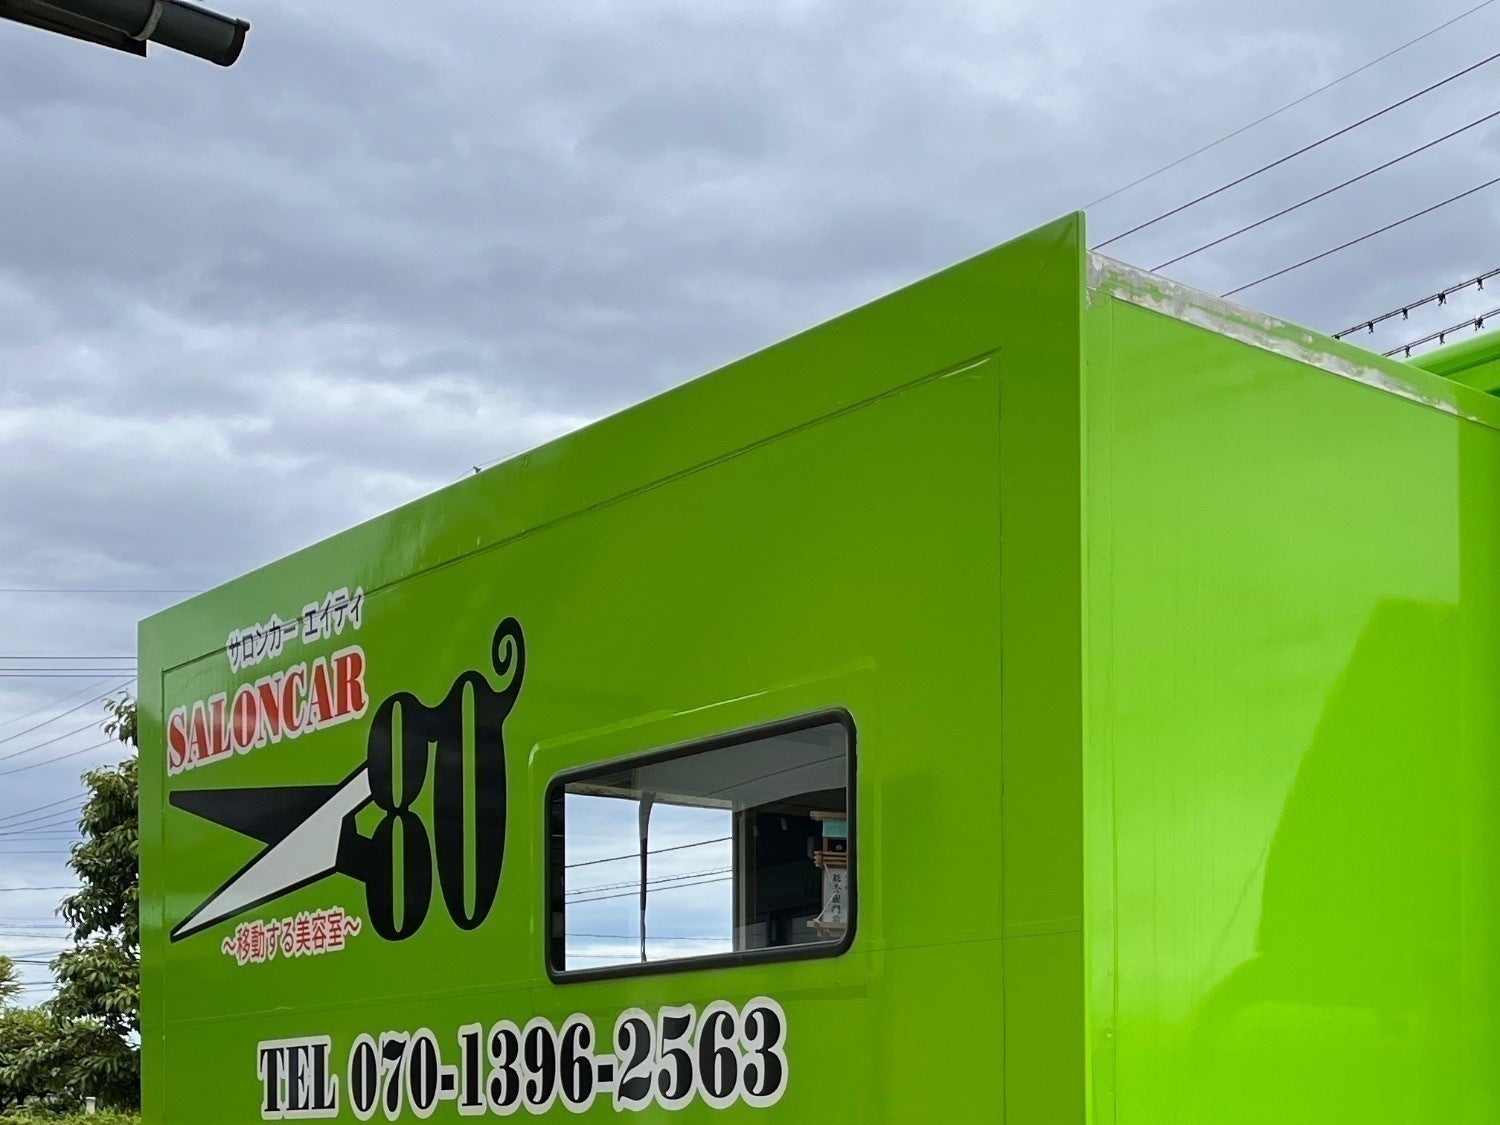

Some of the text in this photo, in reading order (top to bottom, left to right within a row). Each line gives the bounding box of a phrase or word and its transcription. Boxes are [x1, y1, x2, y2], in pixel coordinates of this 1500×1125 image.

[229, 621, 296, 667] サロンカー
[168, 651, 366, 769] SALONCAR
[366, 617, 526, 942] 80
[260, 1007, 783, 1113] TEL 070-1396-2563
